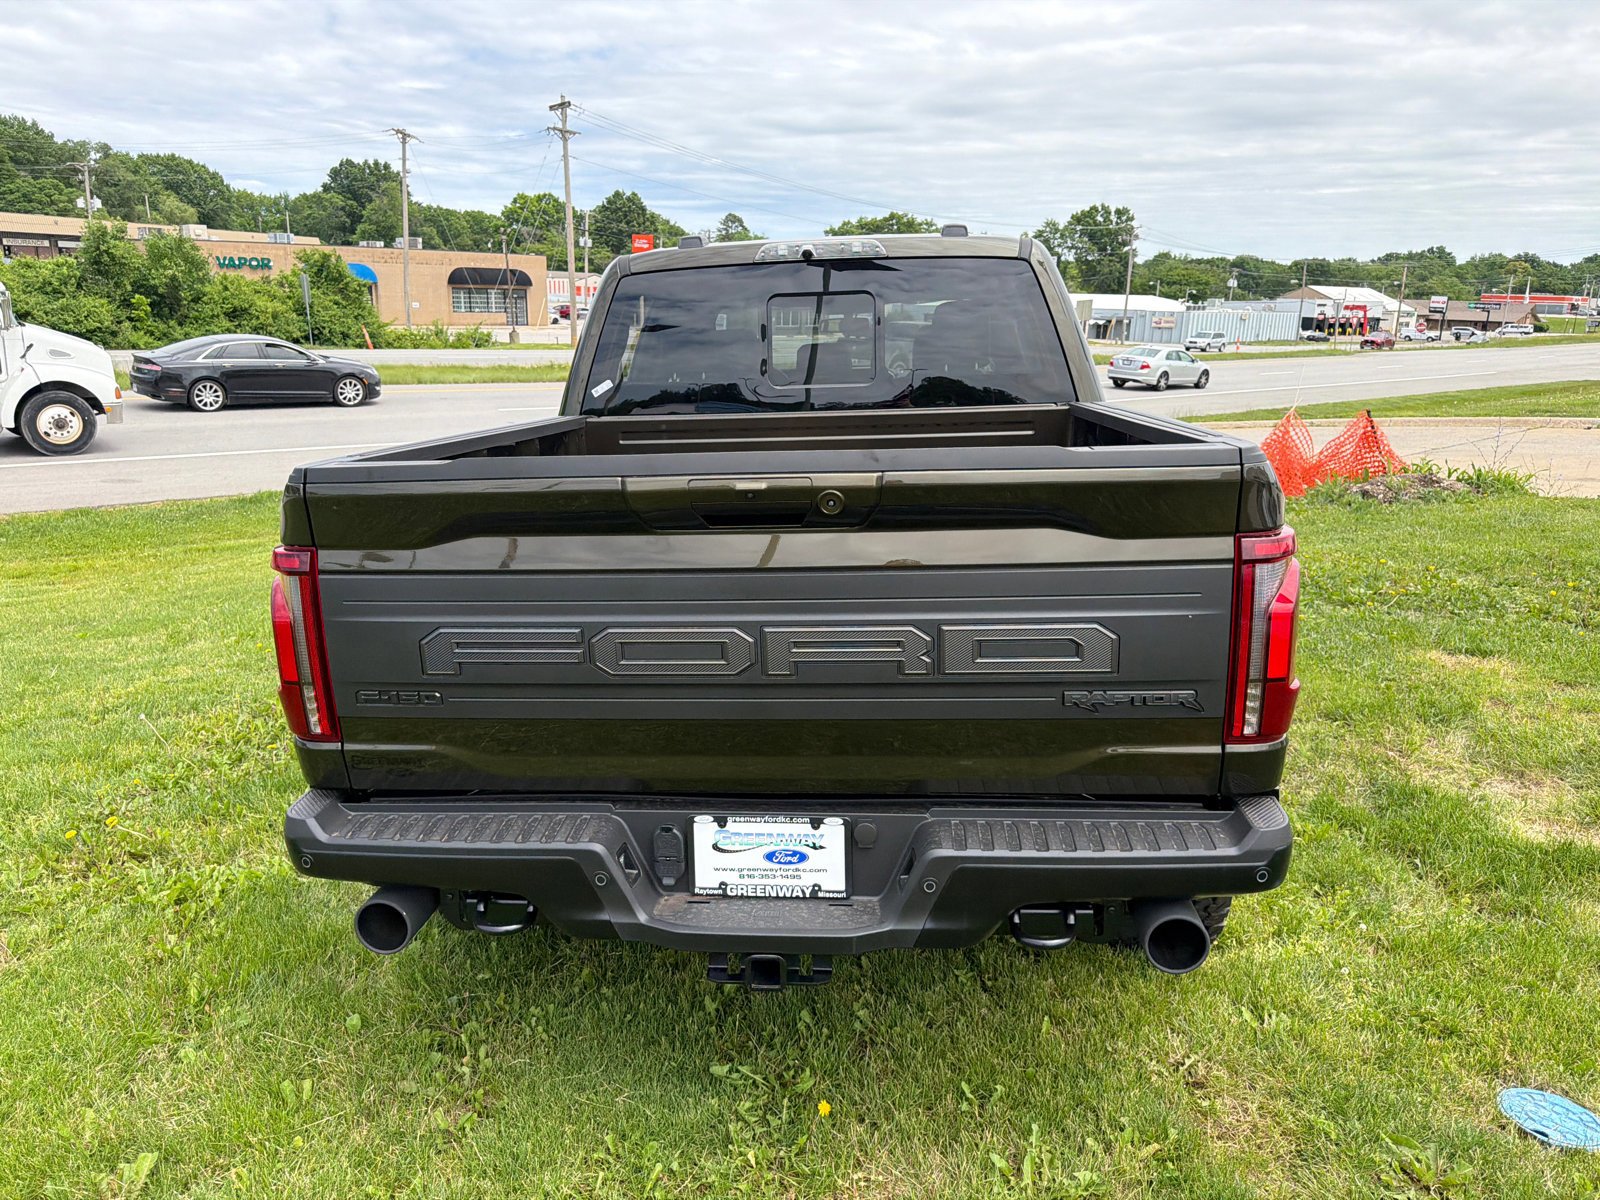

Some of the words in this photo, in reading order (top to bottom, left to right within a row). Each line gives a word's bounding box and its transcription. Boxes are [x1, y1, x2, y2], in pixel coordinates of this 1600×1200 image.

[215, 256, 273, 270] VAPOR
[419, 623, 1121, 678] FORD
[1063, 689, 1205, 714] RAPTOR
[727, 815, 810, 824] greenwayfordkc.com
[713, 829, 825, 848] GREENWAY
[694, 887, 723, 895] Raytown
[726, 884, 813, 898] GREENWAY
